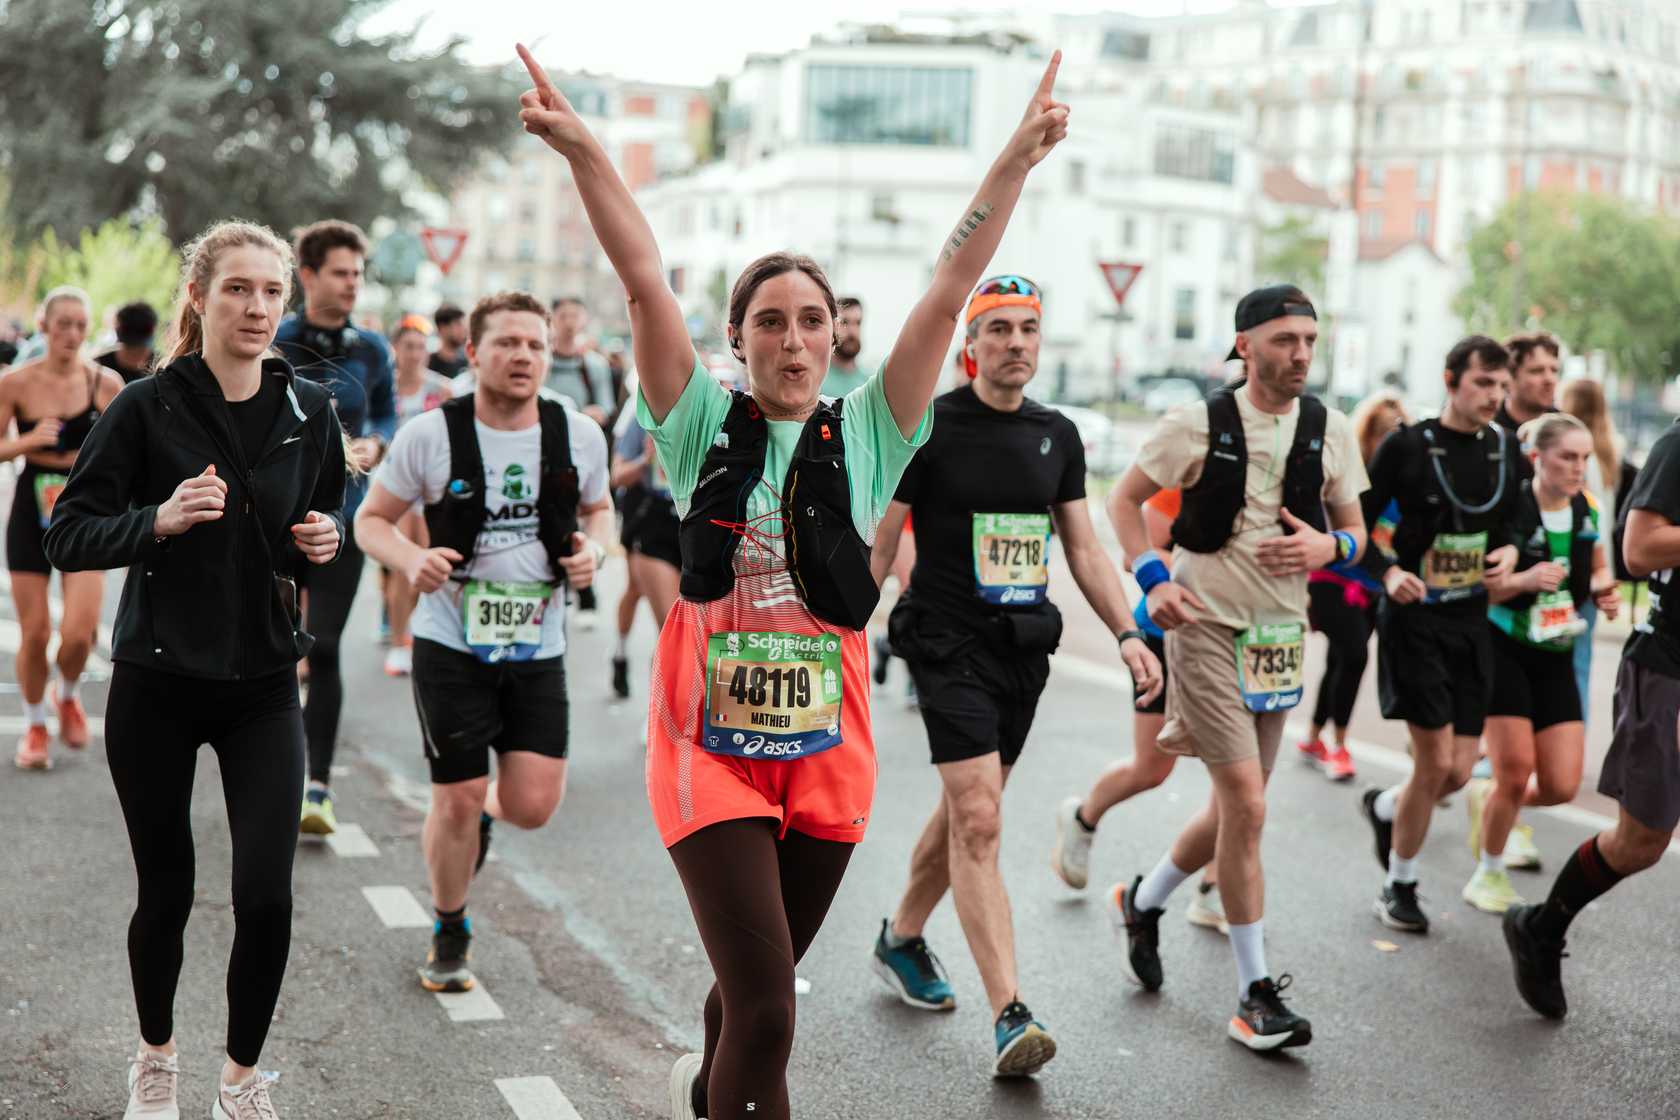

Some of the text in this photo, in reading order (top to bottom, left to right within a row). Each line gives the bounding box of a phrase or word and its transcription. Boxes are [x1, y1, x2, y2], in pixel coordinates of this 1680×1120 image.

[486, 503, 538, 520] MD
[988, 538, 1041, 566] 47218
[728, 665, 812, 708] 48119
[751, 712, 791, 728] MATHIEU
